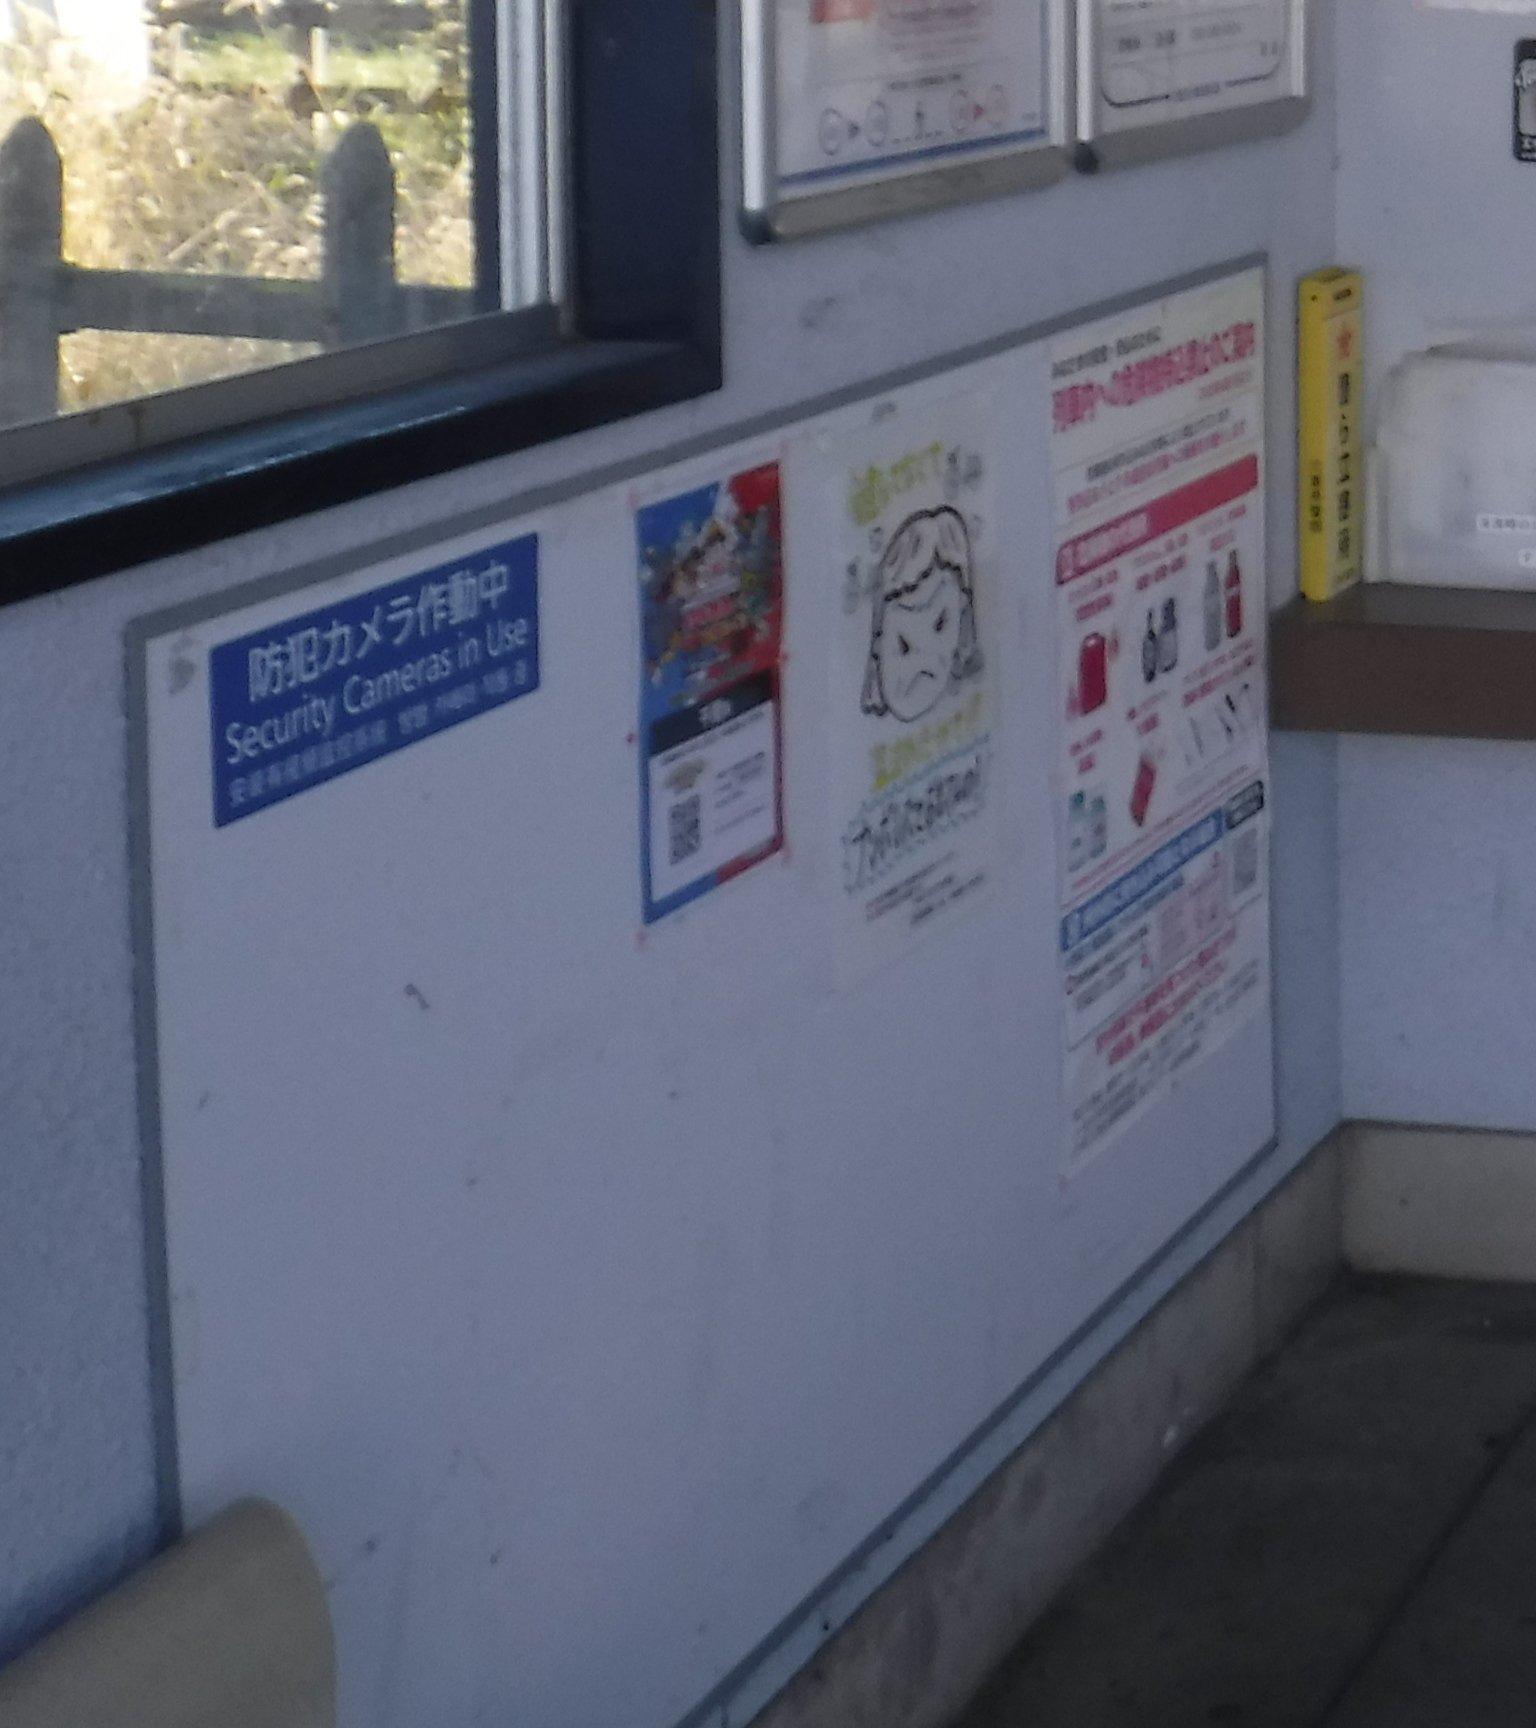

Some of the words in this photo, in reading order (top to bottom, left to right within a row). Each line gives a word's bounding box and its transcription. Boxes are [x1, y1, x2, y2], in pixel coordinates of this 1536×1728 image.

[226, 694, 335, 765] Security
[343, 654, 452, 714] Cameras
[458, 636, 479, 666] in
[486, 616, 528, 658] Use
[248, 560, 509, 703] 防犯カメラ作動中
